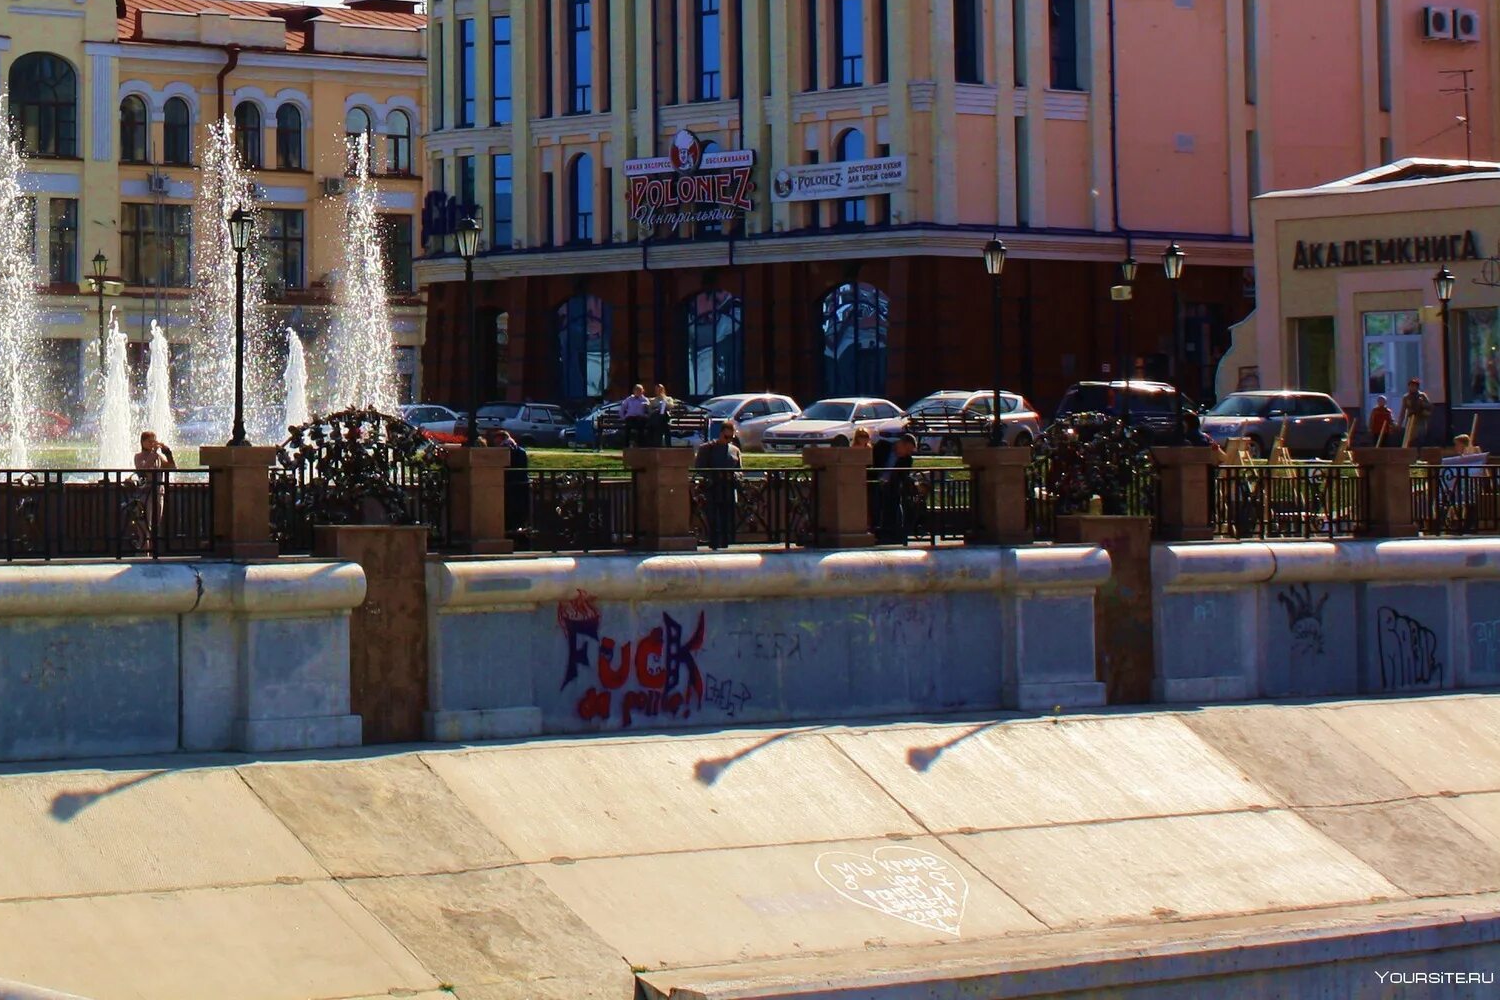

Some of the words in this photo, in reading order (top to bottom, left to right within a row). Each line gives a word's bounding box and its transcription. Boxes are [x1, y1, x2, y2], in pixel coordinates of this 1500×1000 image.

[798, 172, 842, 191] POLONEZ
[847, 164, 882, 174] ДОСТУПНАЯ
[883, 160, 902, 170] КУХНЯ
[630, 166, 752, 219] POLONEZ
[1293, 229, 1478, 270] АКАДЕМКНИГА
[558, 610, 704, 712] FUCK
